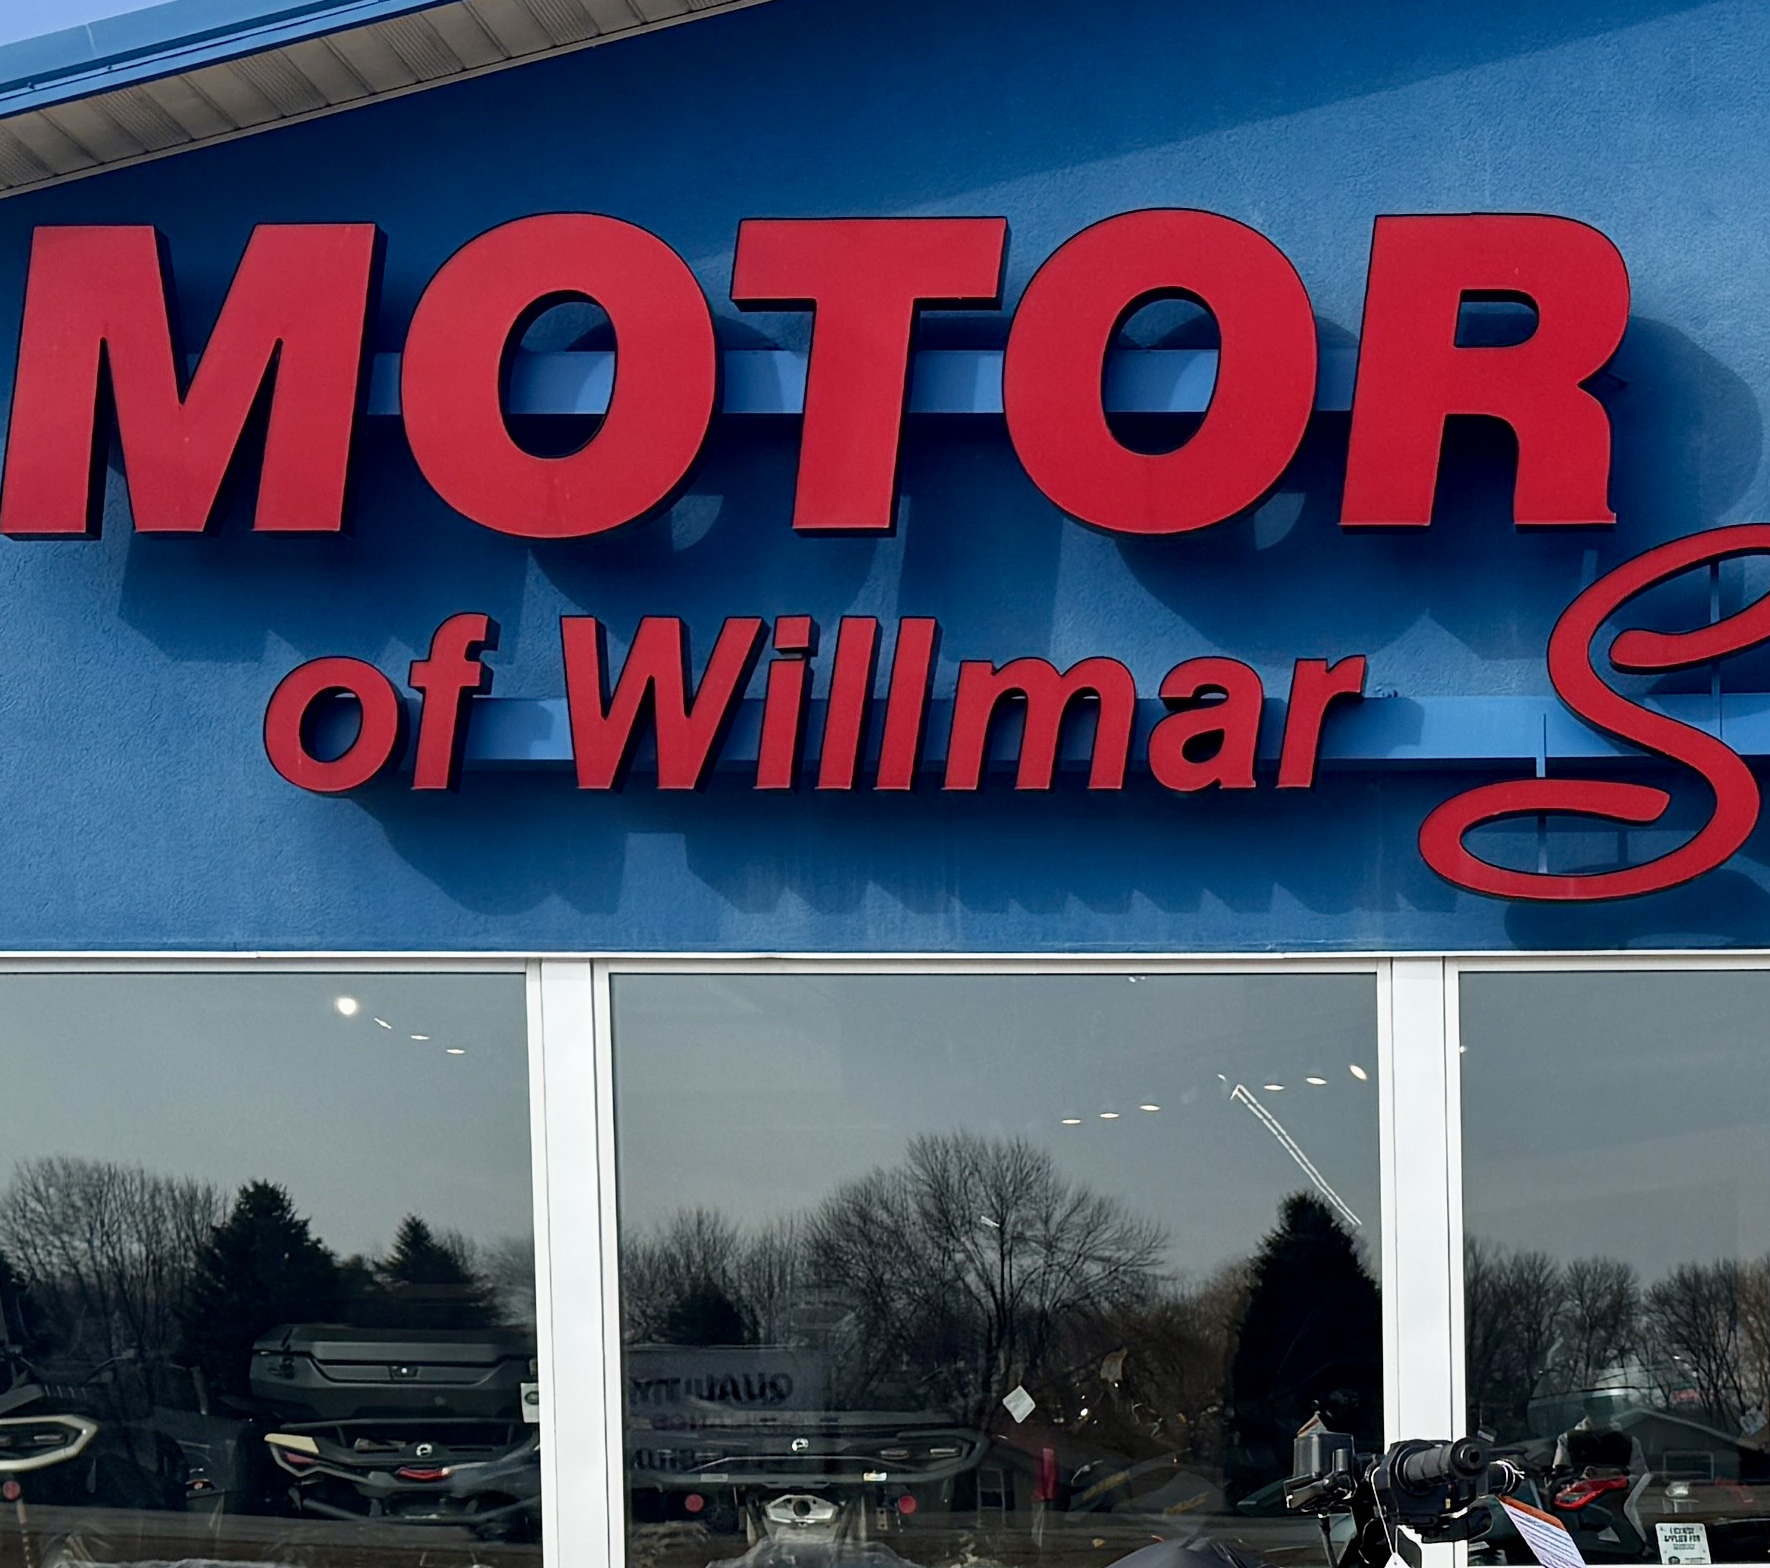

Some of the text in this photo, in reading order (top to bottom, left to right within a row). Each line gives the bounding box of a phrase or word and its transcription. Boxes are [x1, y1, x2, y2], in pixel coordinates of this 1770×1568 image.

[0, 211, 1632, 536] MOTOR
[267, 616, 487, 792] of
[562, 616, 1367, 792] Willmar
